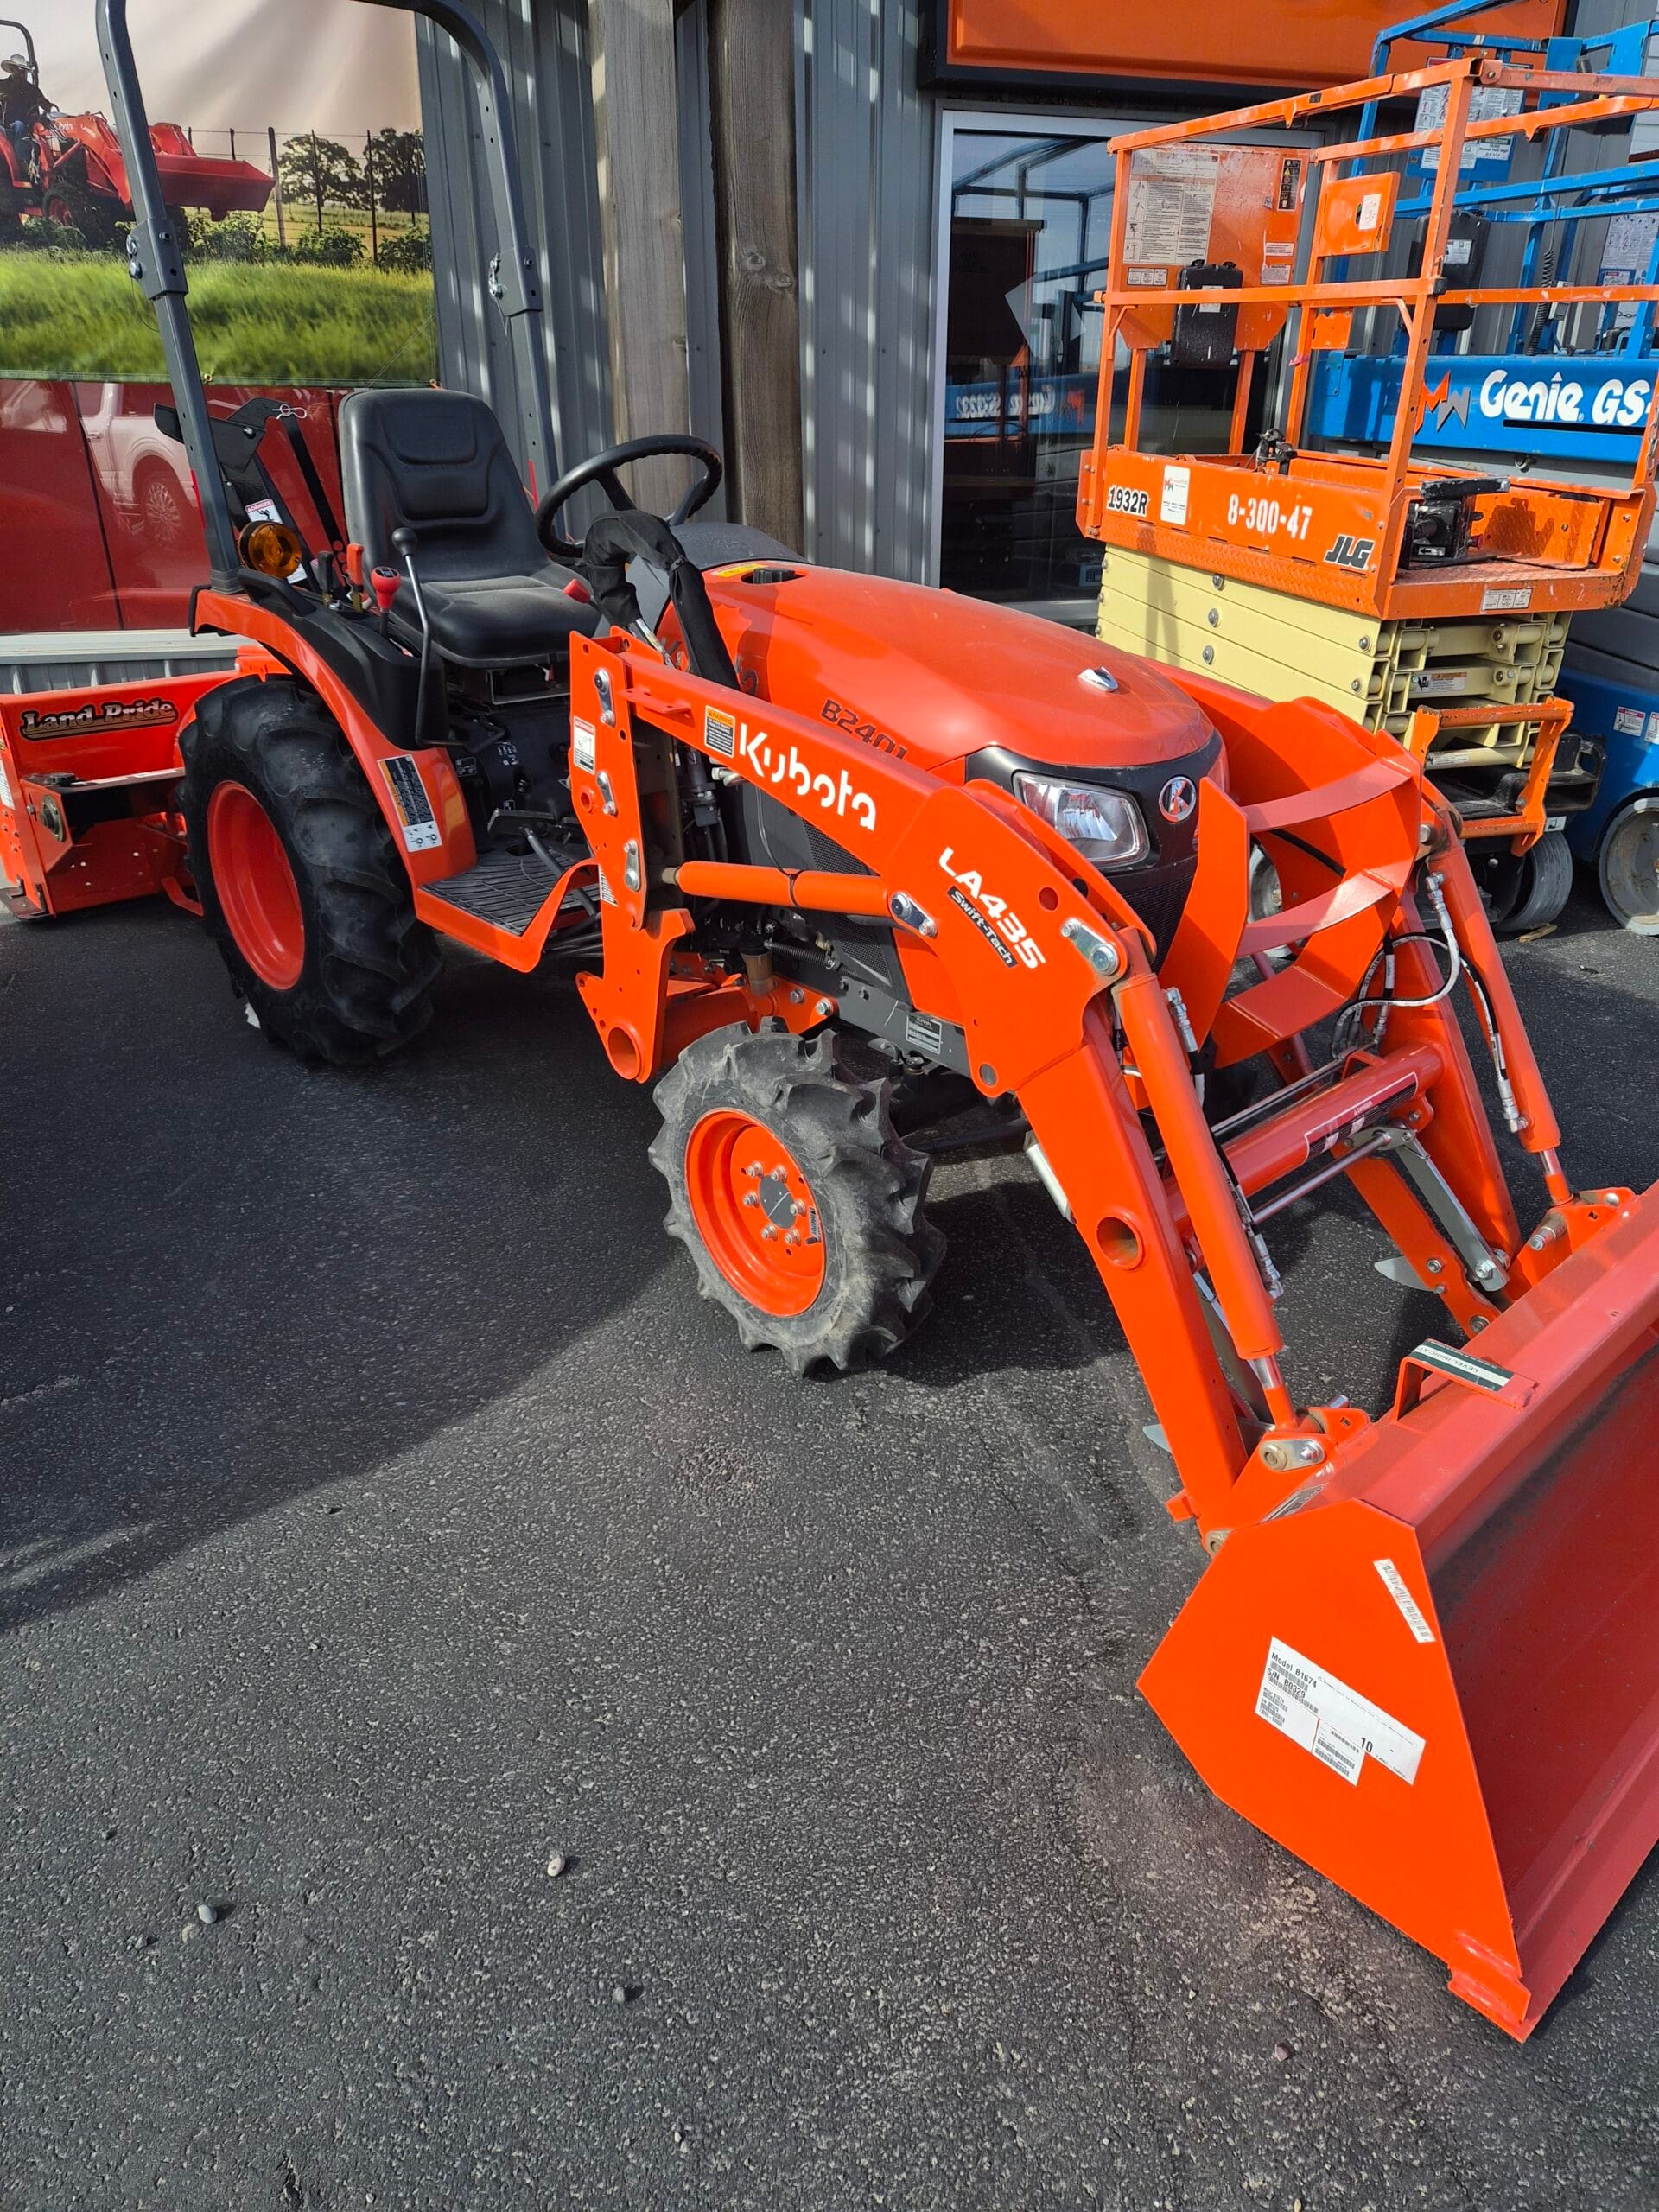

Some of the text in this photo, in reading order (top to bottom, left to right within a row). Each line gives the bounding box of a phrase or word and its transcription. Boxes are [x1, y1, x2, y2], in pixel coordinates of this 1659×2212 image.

[1479, 369, 1584, 422] Genie
[1108, 486, 1147, 516] 1932R
[1228, 493, 1313, 540] 8-300-47
[1325, 535, 1374, 569] JLG
[23, 699, 175, 733] Land Pride
[740, 722, 876, 831] Kubota
[939, 846, 1046, 969] LA435
[950, 889, 1013, 965] Swift-Tach
[1453, 1359, 1479, 1374] LEVEL
[1267, 1667, 1306, 1699] S/N B0329
[1271, 1651, 1318, 1688] Model B1674
[1361, 1737, 1374, 1753] 10
